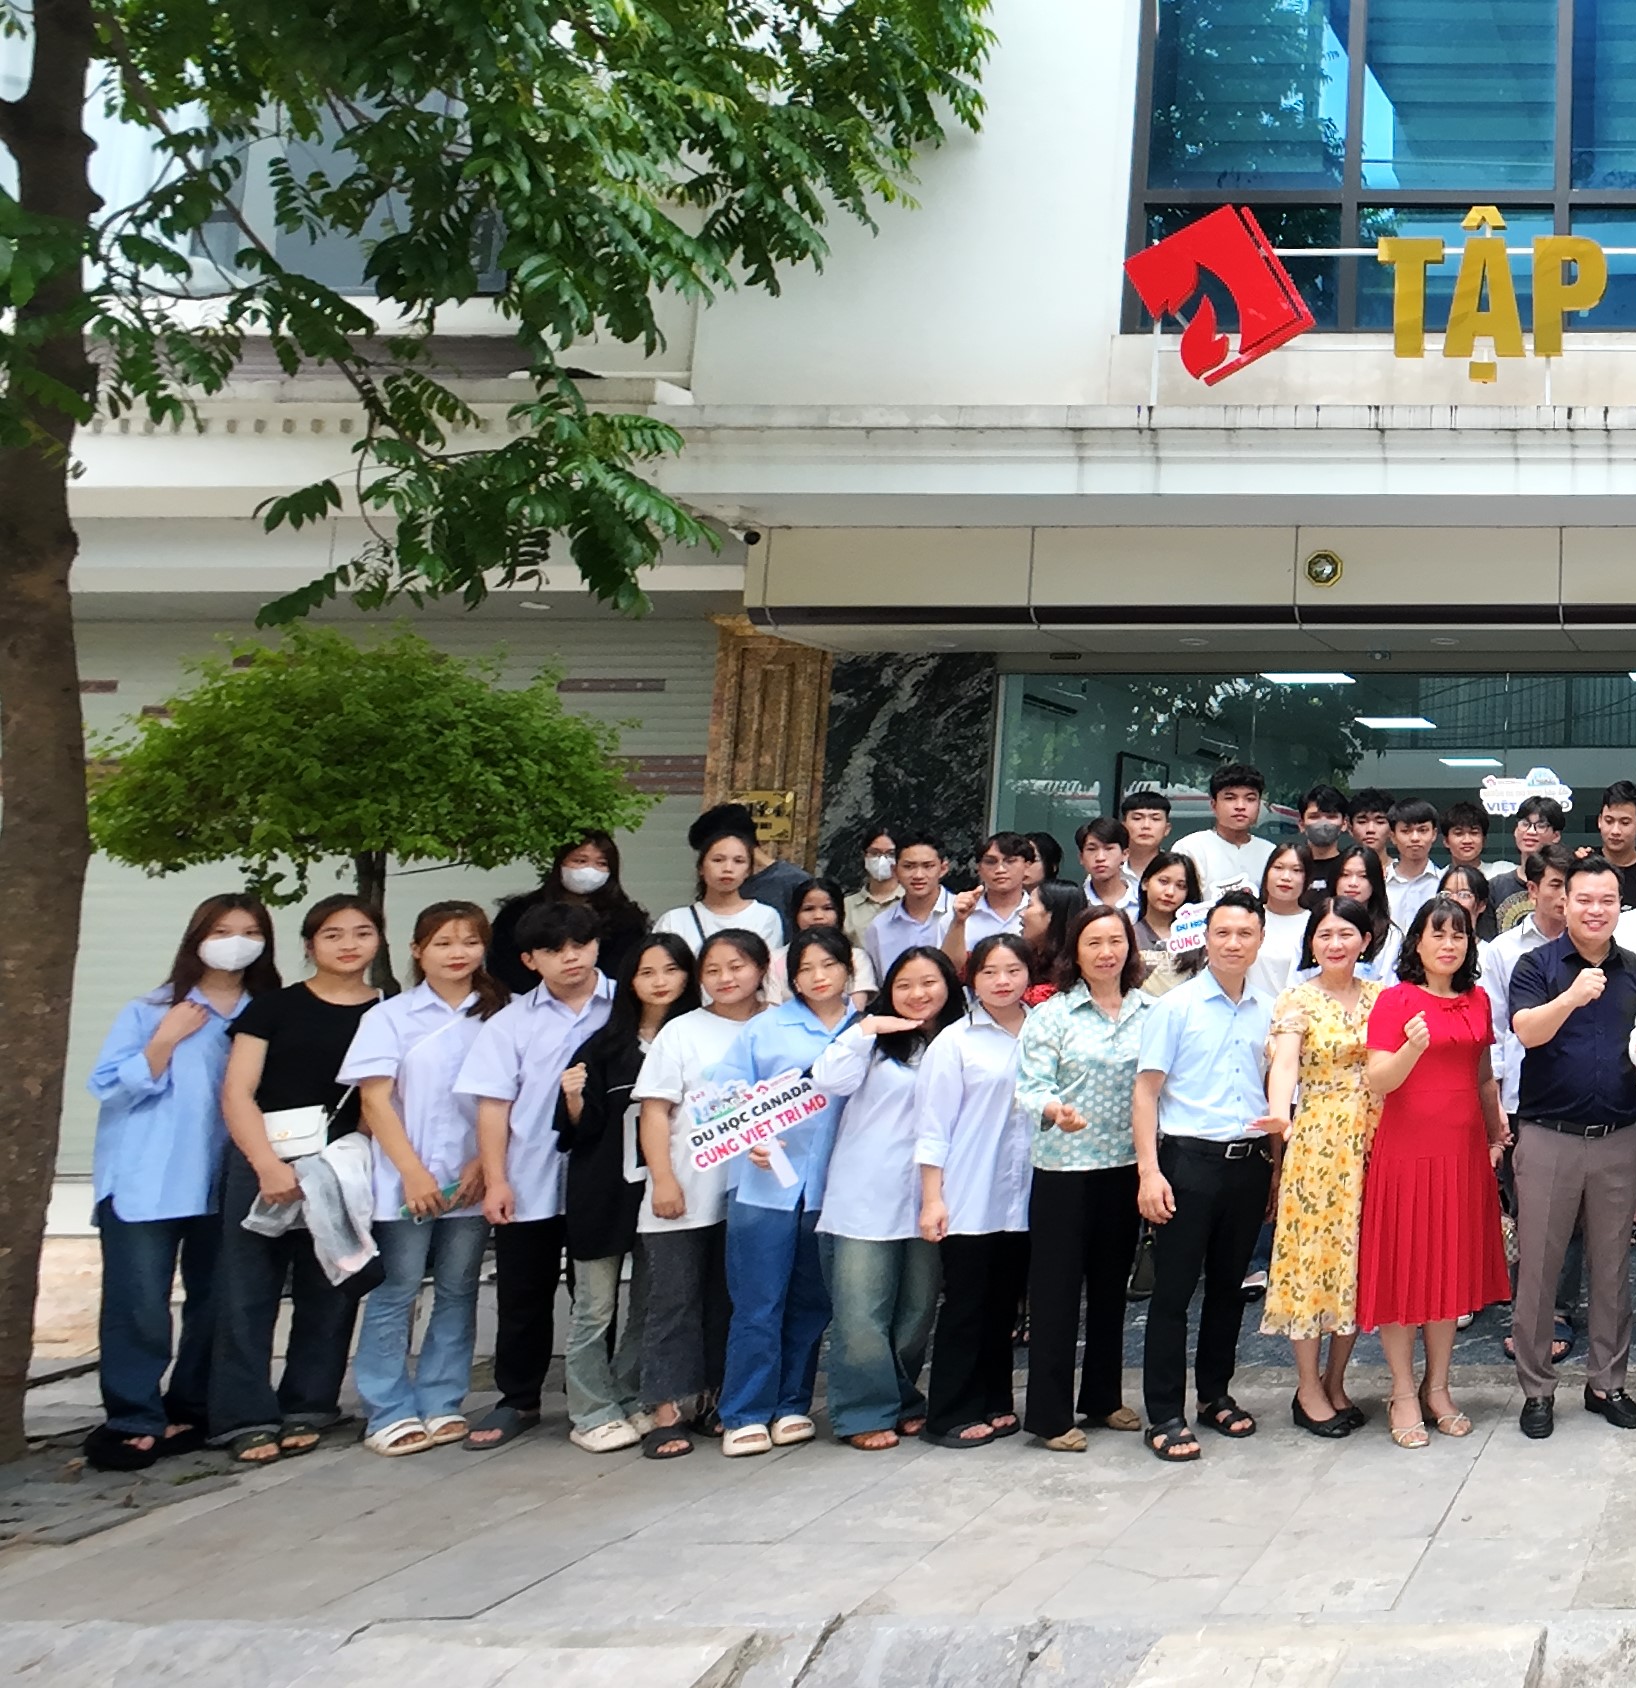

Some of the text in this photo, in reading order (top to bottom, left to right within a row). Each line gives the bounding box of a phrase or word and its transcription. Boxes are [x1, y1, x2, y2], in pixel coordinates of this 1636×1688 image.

[1377, 205, 1608, 384] TẬP
[1486, 800, 1518, 813] VIỆT
[690, 1080, 813, 1148] DU HỌC CANADA
[694, 1093, 828, 1169] CÙNG VIỆT TRÍ MD
